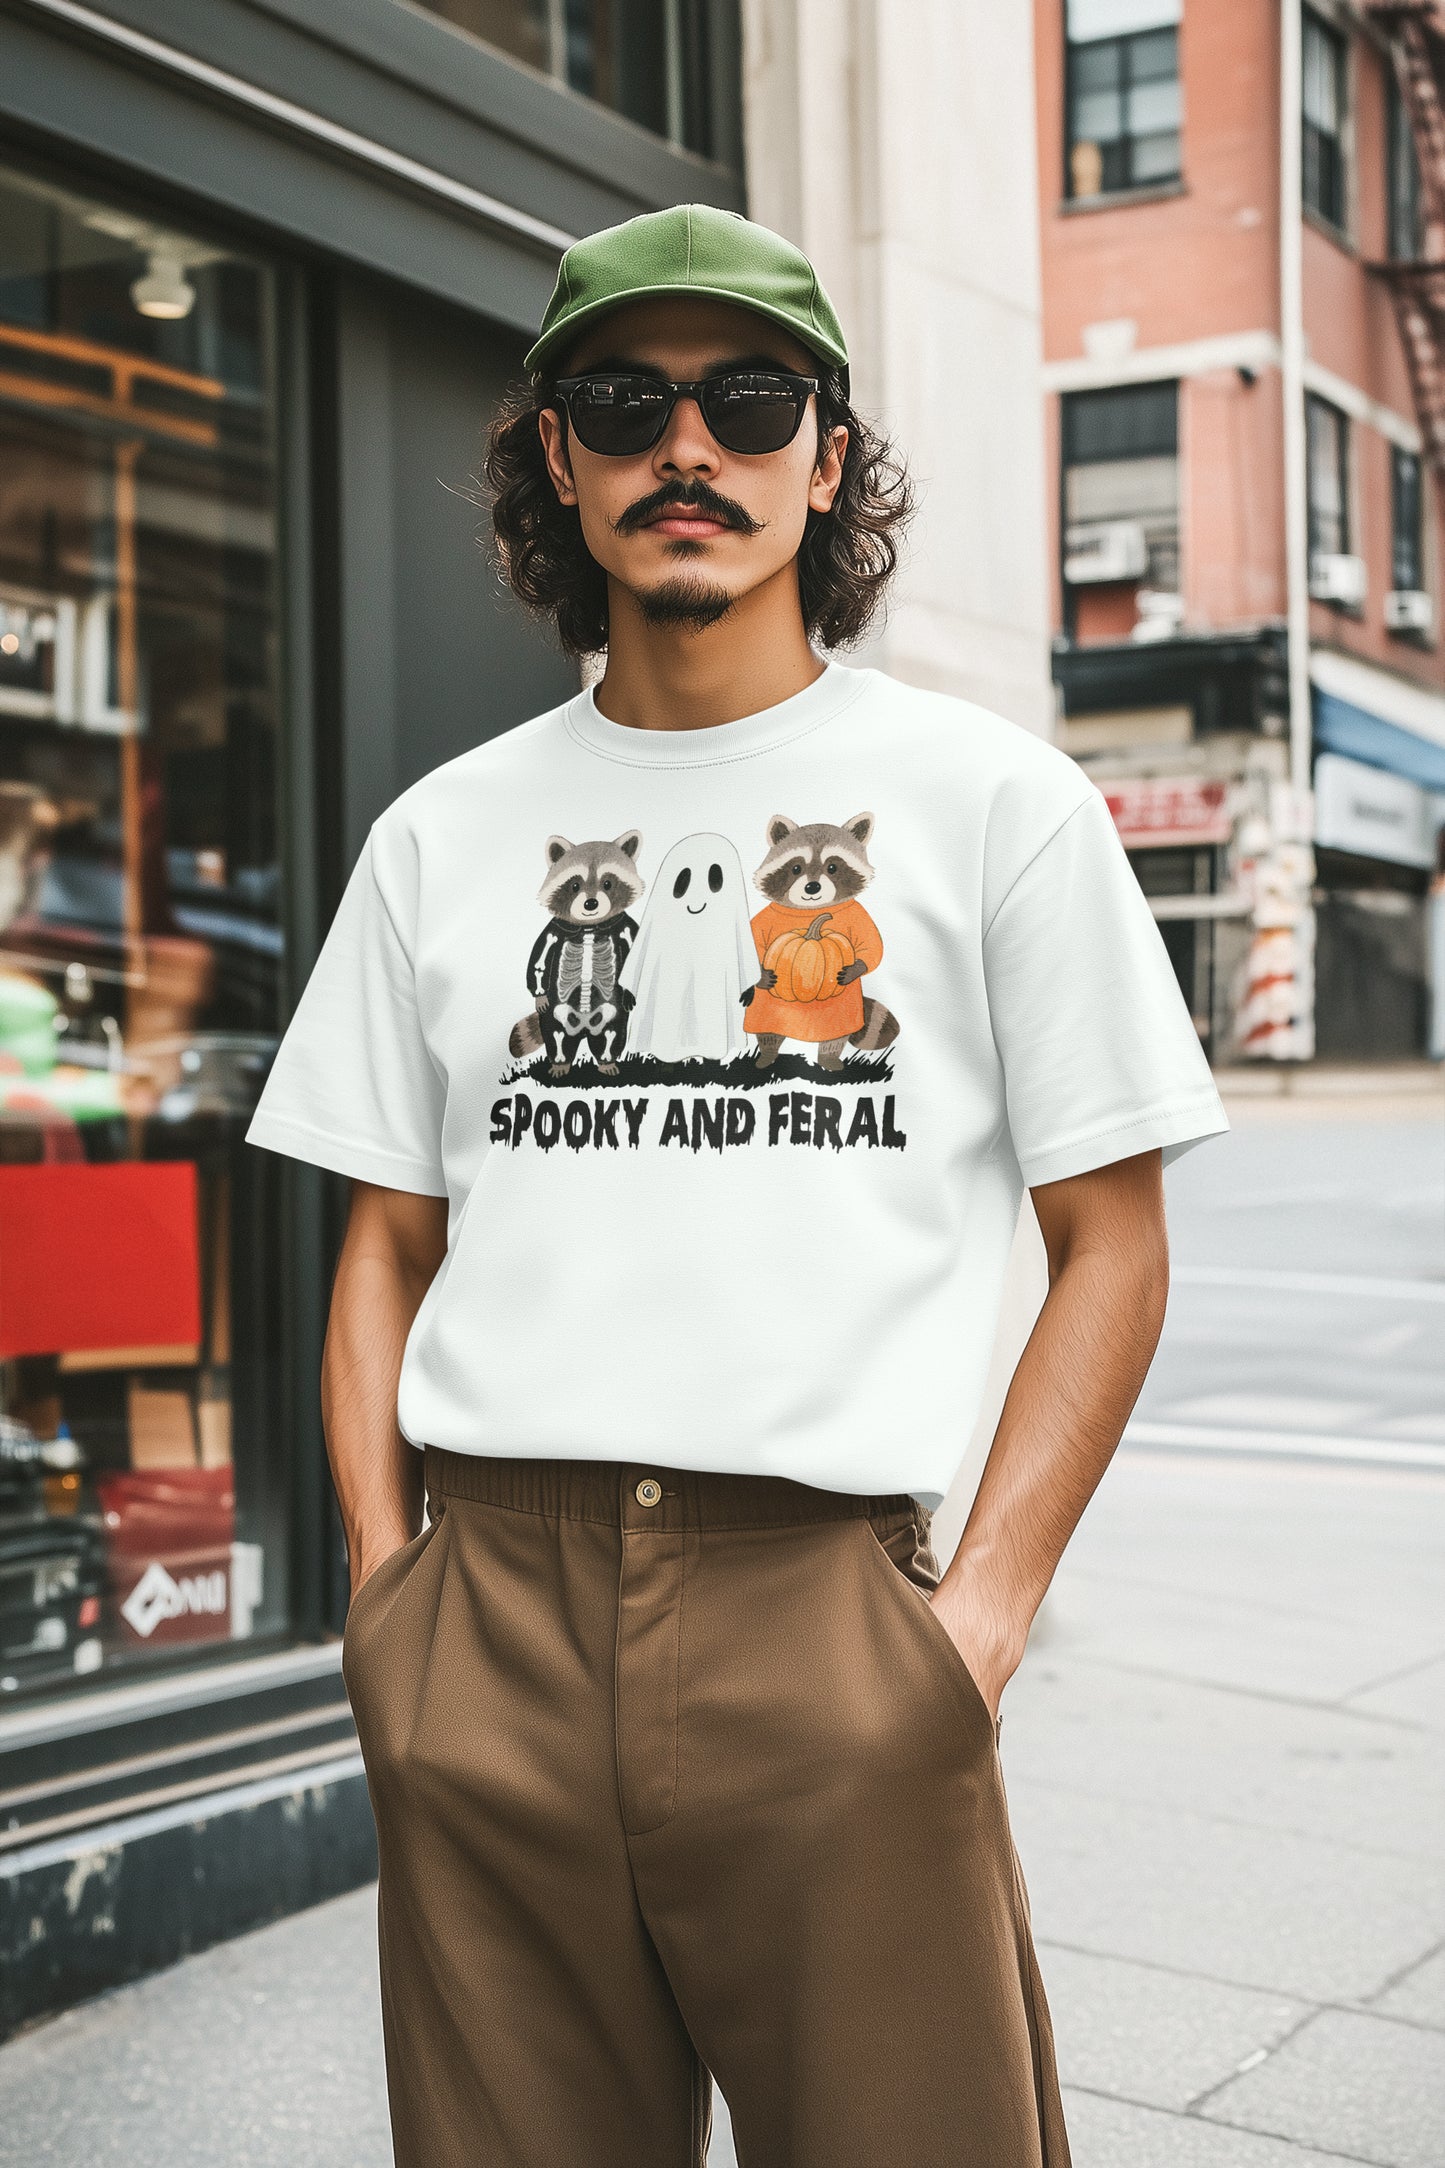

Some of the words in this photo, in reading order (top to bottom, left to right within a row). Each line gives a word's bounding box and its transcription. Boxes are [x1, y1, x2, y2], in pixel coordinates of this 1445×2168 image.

[489, 1093, 650, 1154] SPOOKY
[658, 1097, 756, 1155] AND
[768, 1090, 907, 1154] FERAL
